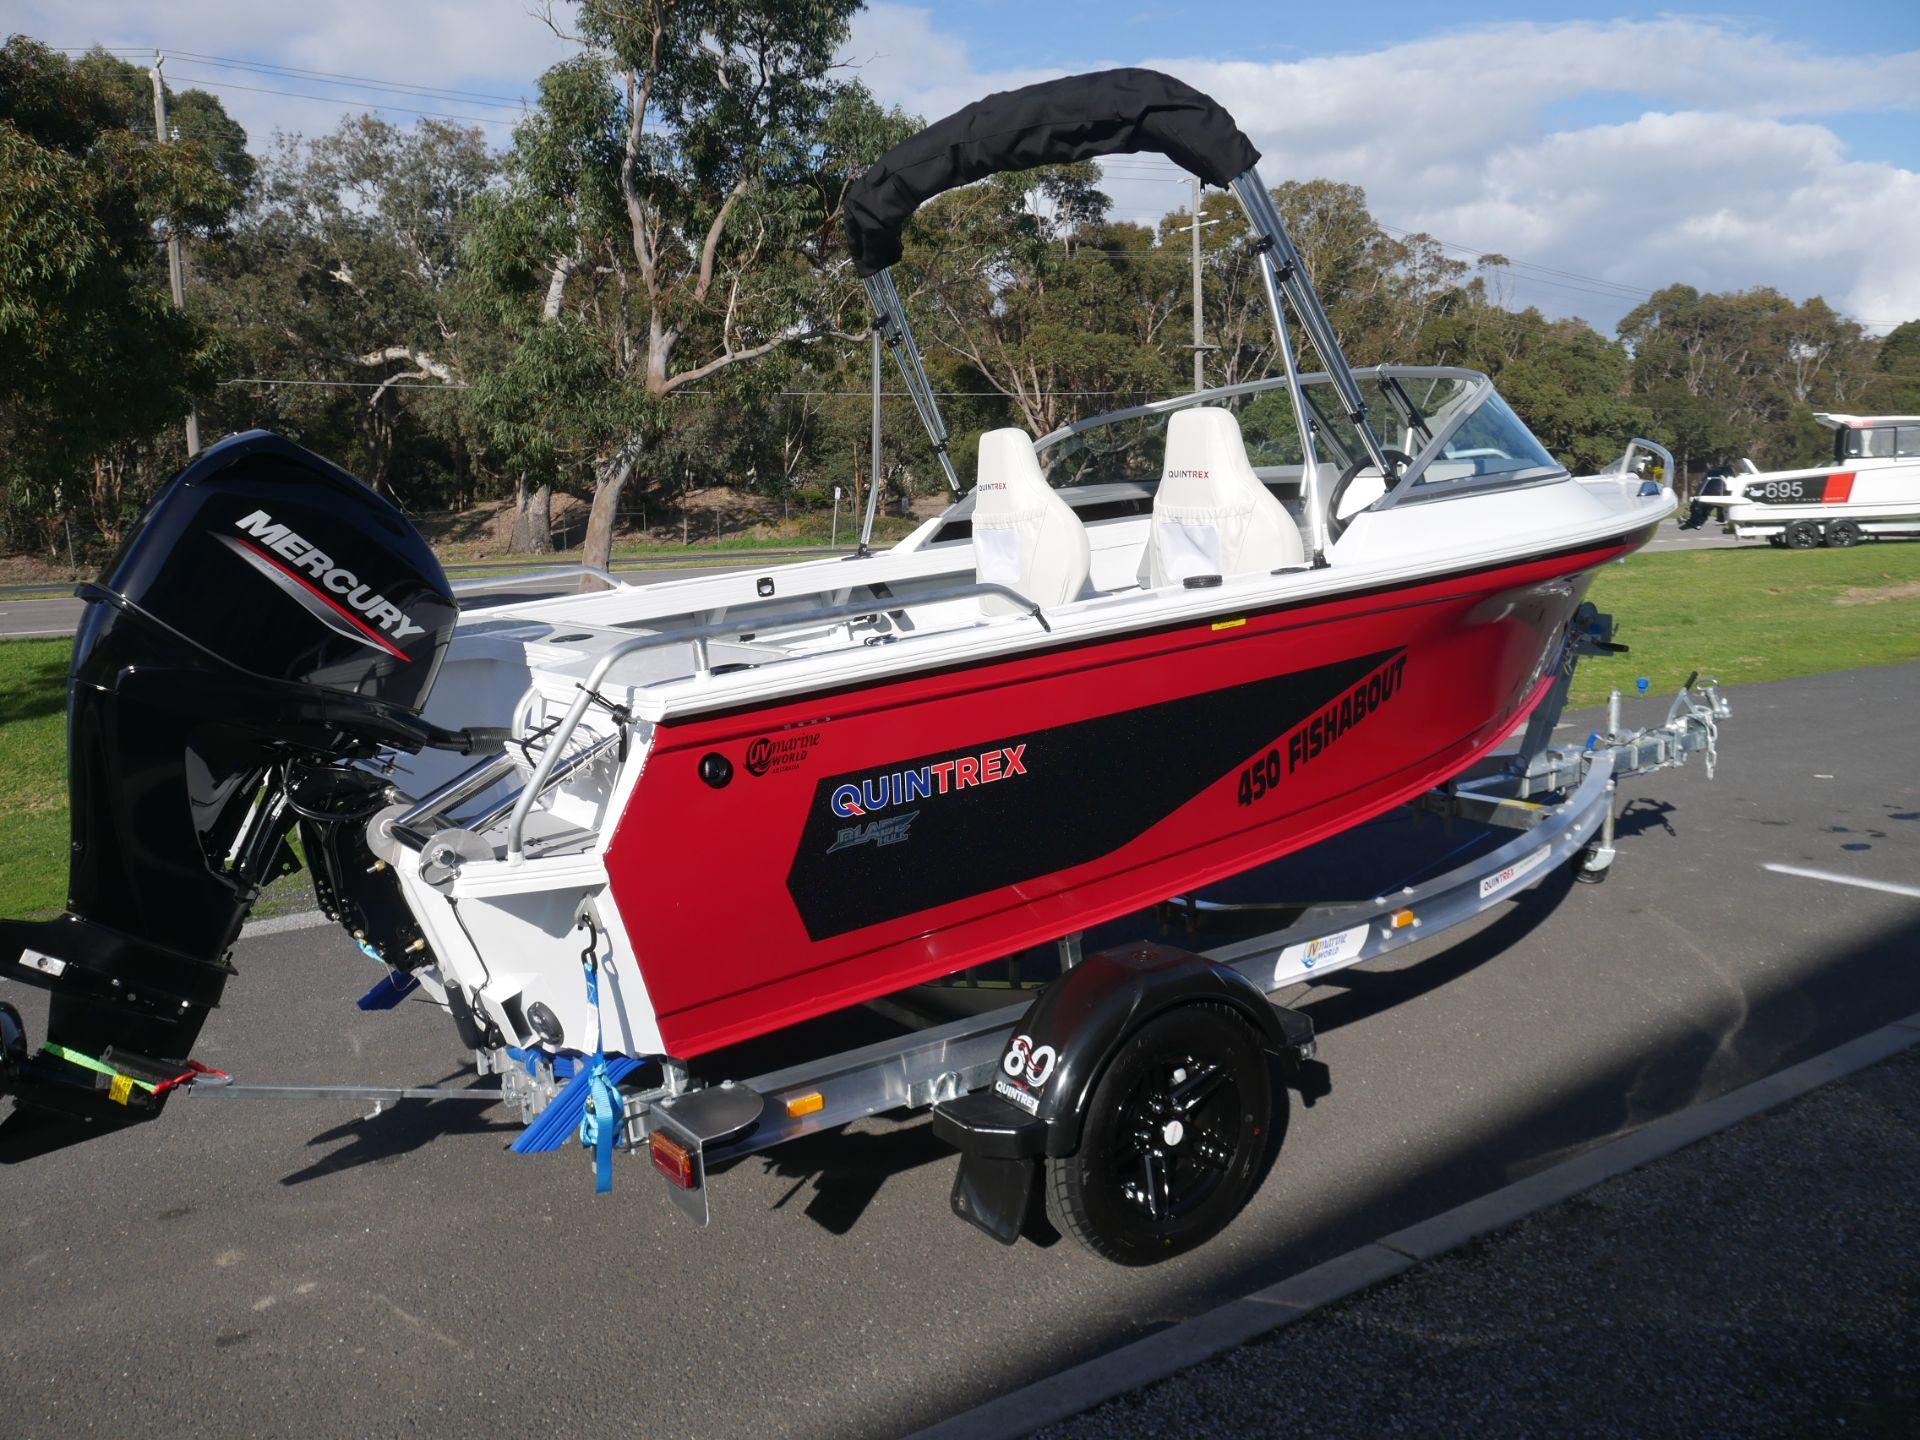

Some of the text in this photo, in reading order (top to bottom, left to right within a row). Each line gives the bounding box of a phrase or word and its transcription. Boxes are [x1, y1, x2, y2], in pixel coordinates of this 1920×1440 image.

[1168, 470, 1209, 479] QUINTREX
[979, 482, 1007, 492] QUINTREX
[1765, 482, 1804, 498] 695
[235, 509, 425, 639] MERCURY
[1238, 653, 1408, 806] 450 FISHABOUT
[771, 732, 822, 754] marine
[772, 750, 807, 766] WORLD
[831, 743, 1027, 818] QUINTREX
[836, 814, 913, 845] BLADE
[1484, 867, 1514, 891] QUINTREX
[1318, 933, 1348, 951] marine
[1318, 946, 1340, 960] WORLD
[995, 1080, 1040, 1112] QUINTREX
